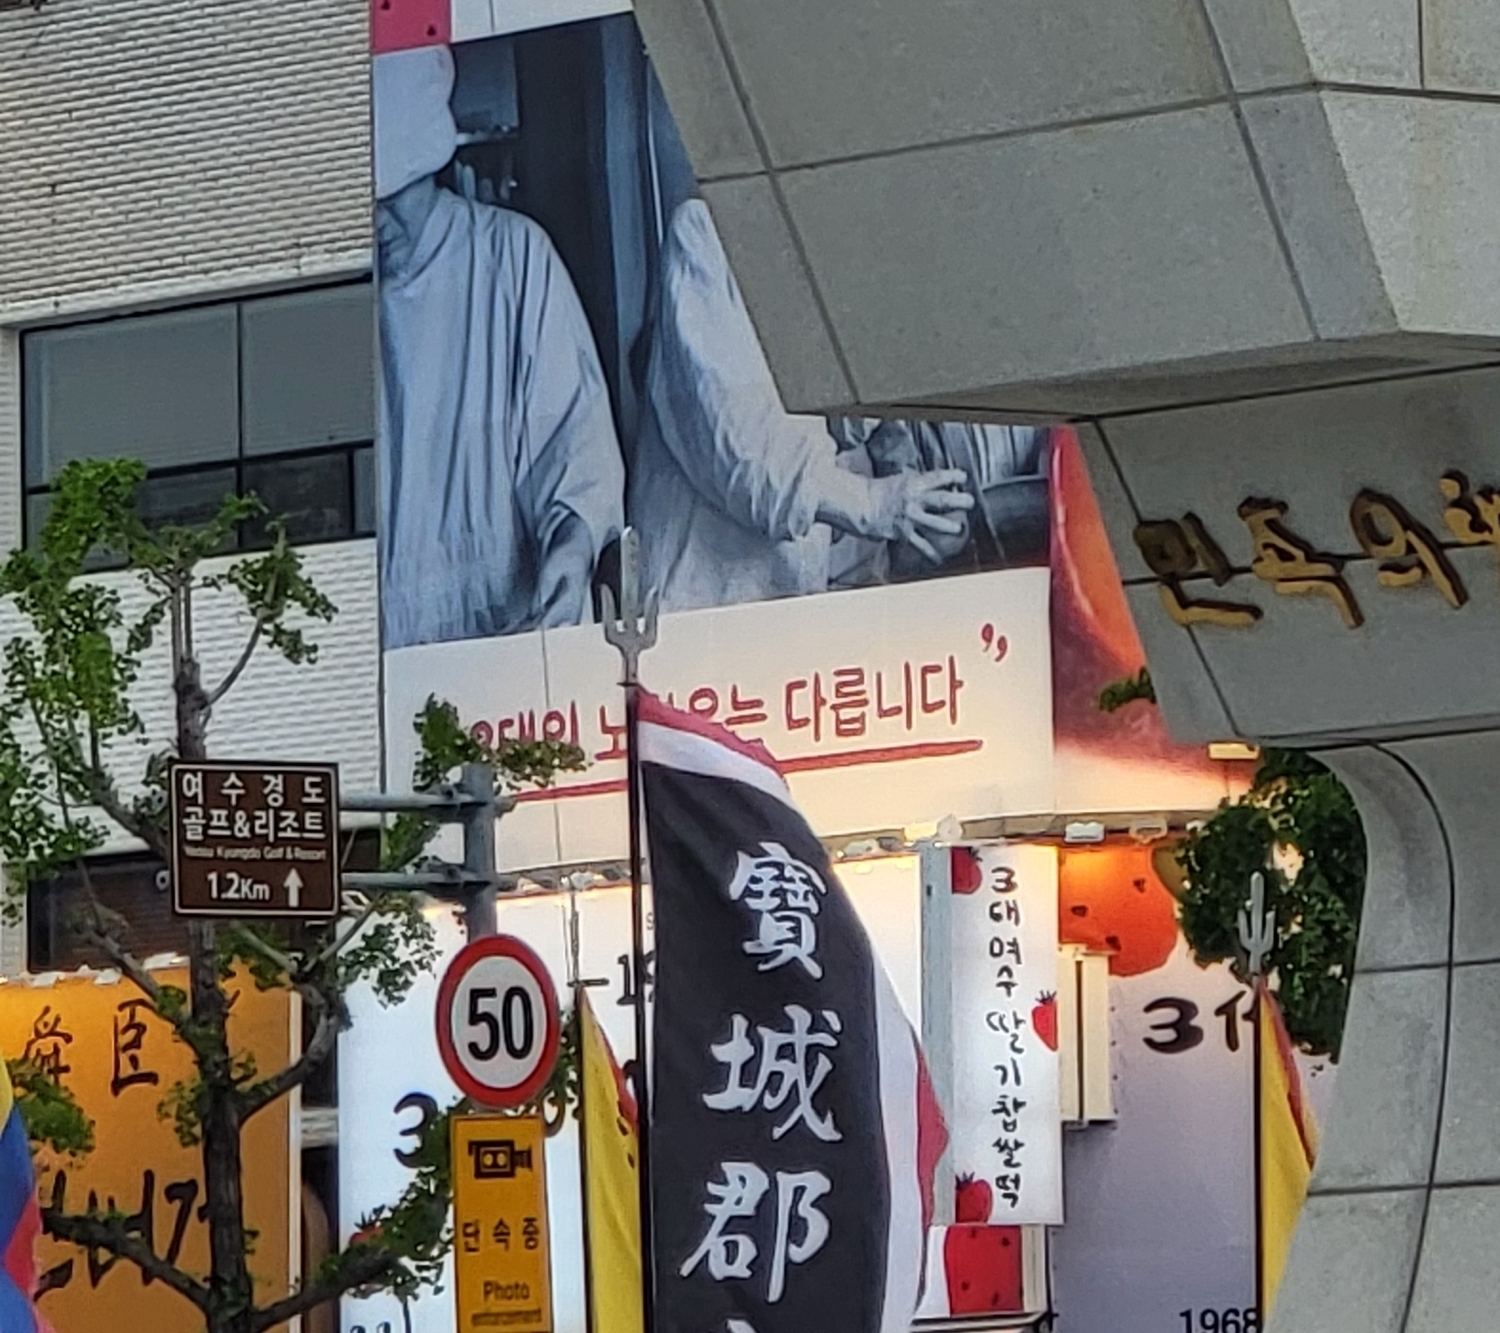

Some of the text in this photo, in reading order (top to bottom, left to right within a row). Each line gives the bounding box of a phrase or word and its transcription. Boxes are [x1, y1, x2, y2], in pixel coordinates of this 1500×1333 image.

[786, 655, 965, 741] 다릅니다
[182, 771, 326, 807] 여수경도
[182, 806, 326, 843] 골프&리조트
[467, 986, 535, 1062] 50
[679, 841, 843, 1333] 寶城郡
[483, 1281, 531, 1301] Photo
